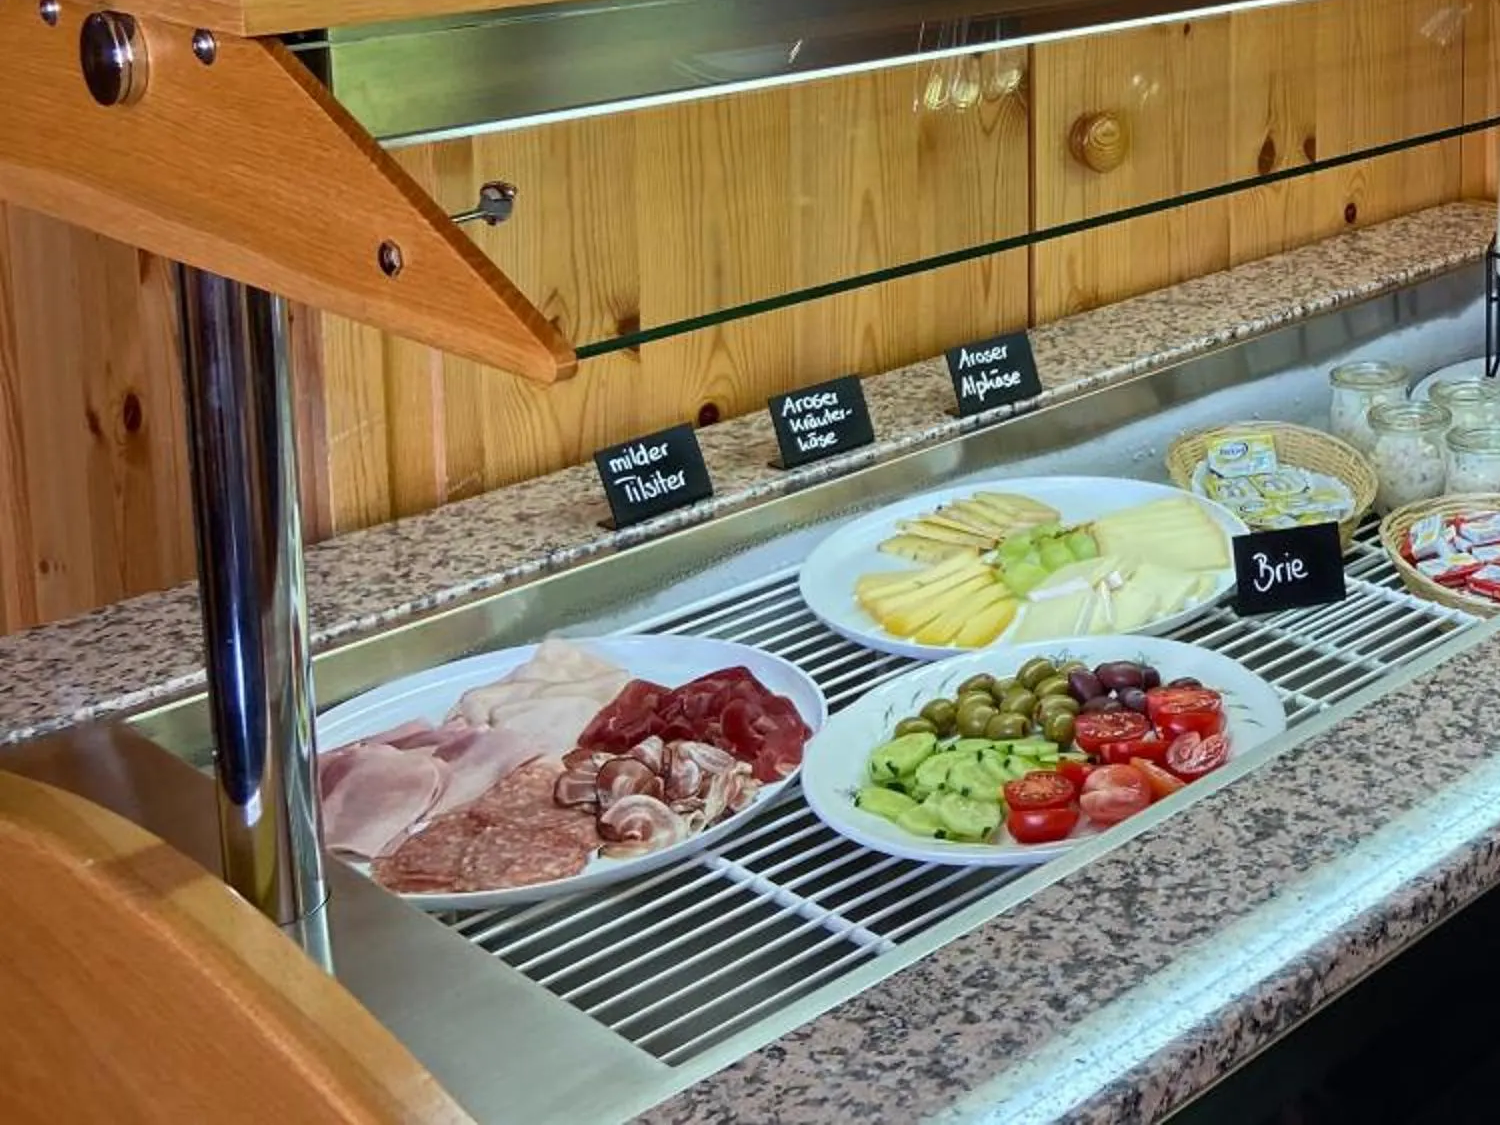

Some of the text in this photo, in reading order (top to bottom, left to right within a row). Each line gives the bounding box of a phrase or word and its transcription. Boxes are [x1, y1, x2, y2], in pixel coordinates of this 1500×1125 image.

[959, 345, 1008, 369] Aroser
[782, 392, 839, 417] Aroser
[609, 442, 669, 473] milder
[614, 470, 686, 503] Tilsiter
[1253, 552, 1309, 592] Brie
